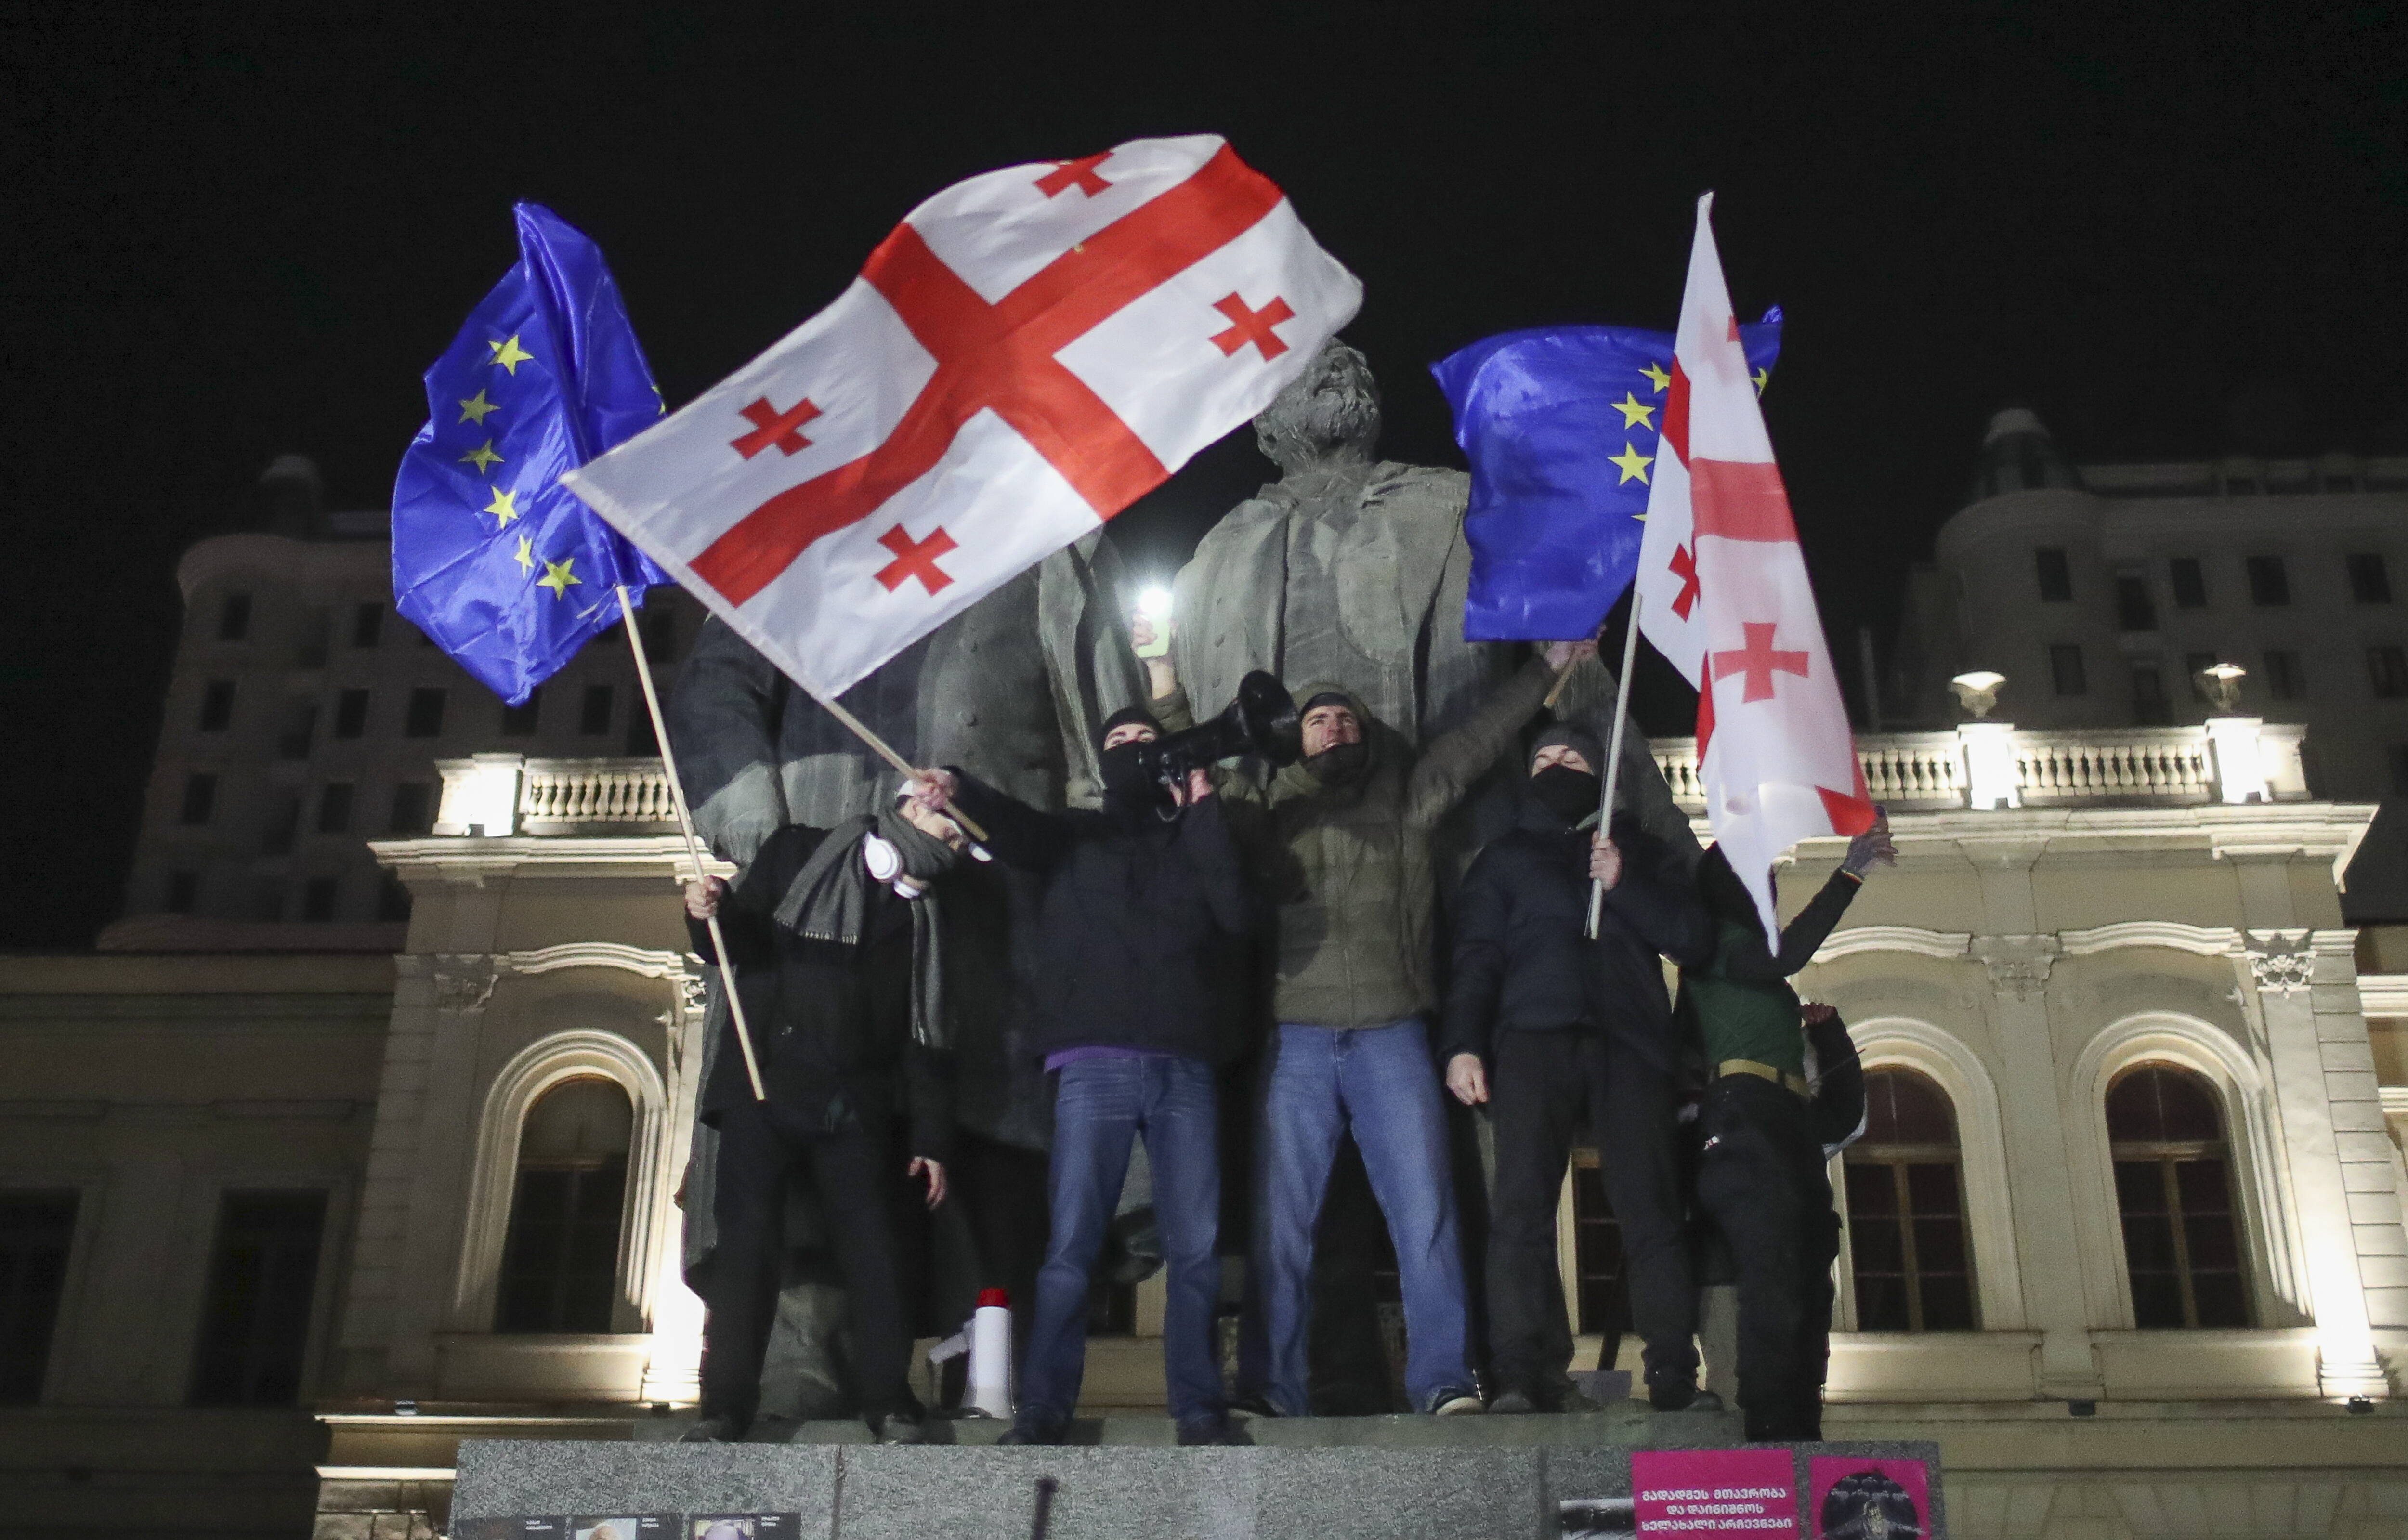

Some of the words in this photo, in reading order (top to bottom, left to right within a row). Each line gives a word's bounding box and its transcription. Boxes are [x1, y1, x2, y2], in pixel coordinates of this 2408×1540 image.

[1714, 1488, 1786, 1499] მთავრობა
[1666, 1505, 1685, 1515] და
[1687, 1504, 1764, 1514] დაინიშნოს
[1642, 1519, 1715, 1531] ხელახალი
[1718, 1518, 1792, 1529] არჩევნები
